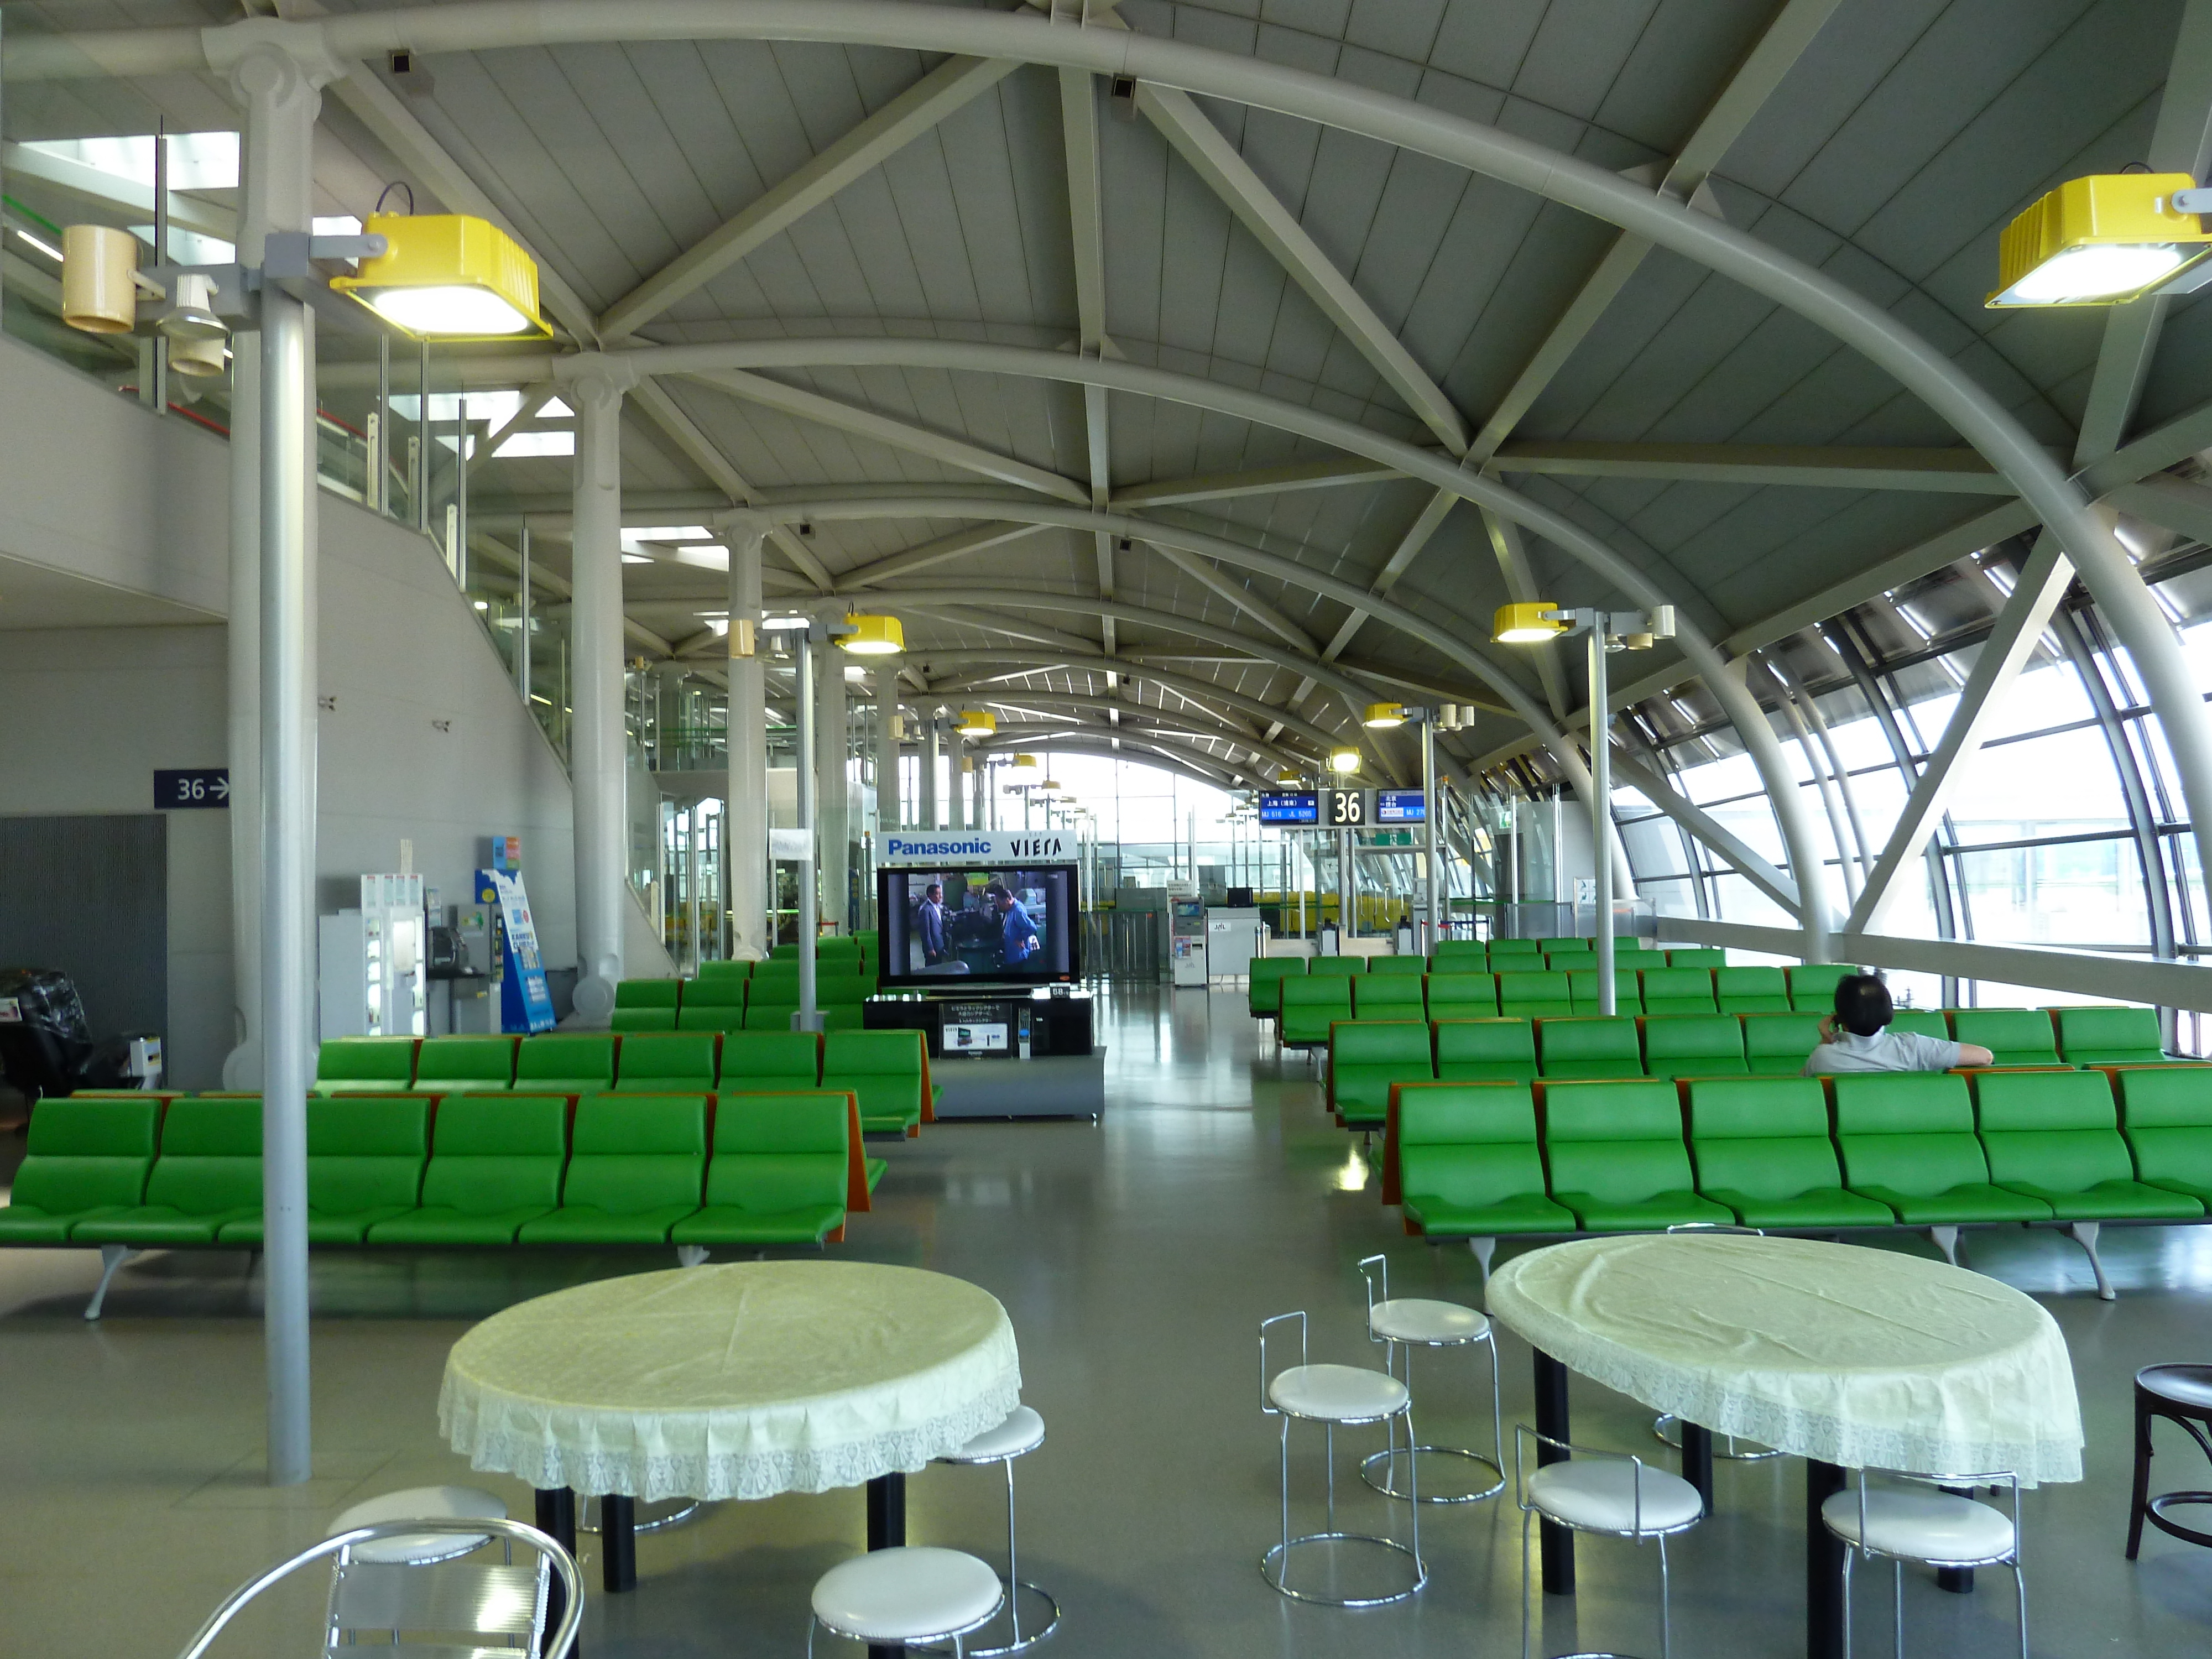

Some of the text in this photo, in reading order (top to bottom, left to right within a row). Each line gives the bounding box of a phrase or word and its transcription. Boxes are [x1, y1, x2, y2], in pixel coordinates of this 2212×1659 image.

[178, 778, 205, 800] 36
[1335, 792, 1360, 822] 36
[888, 838, 992, 855] Panasonic
